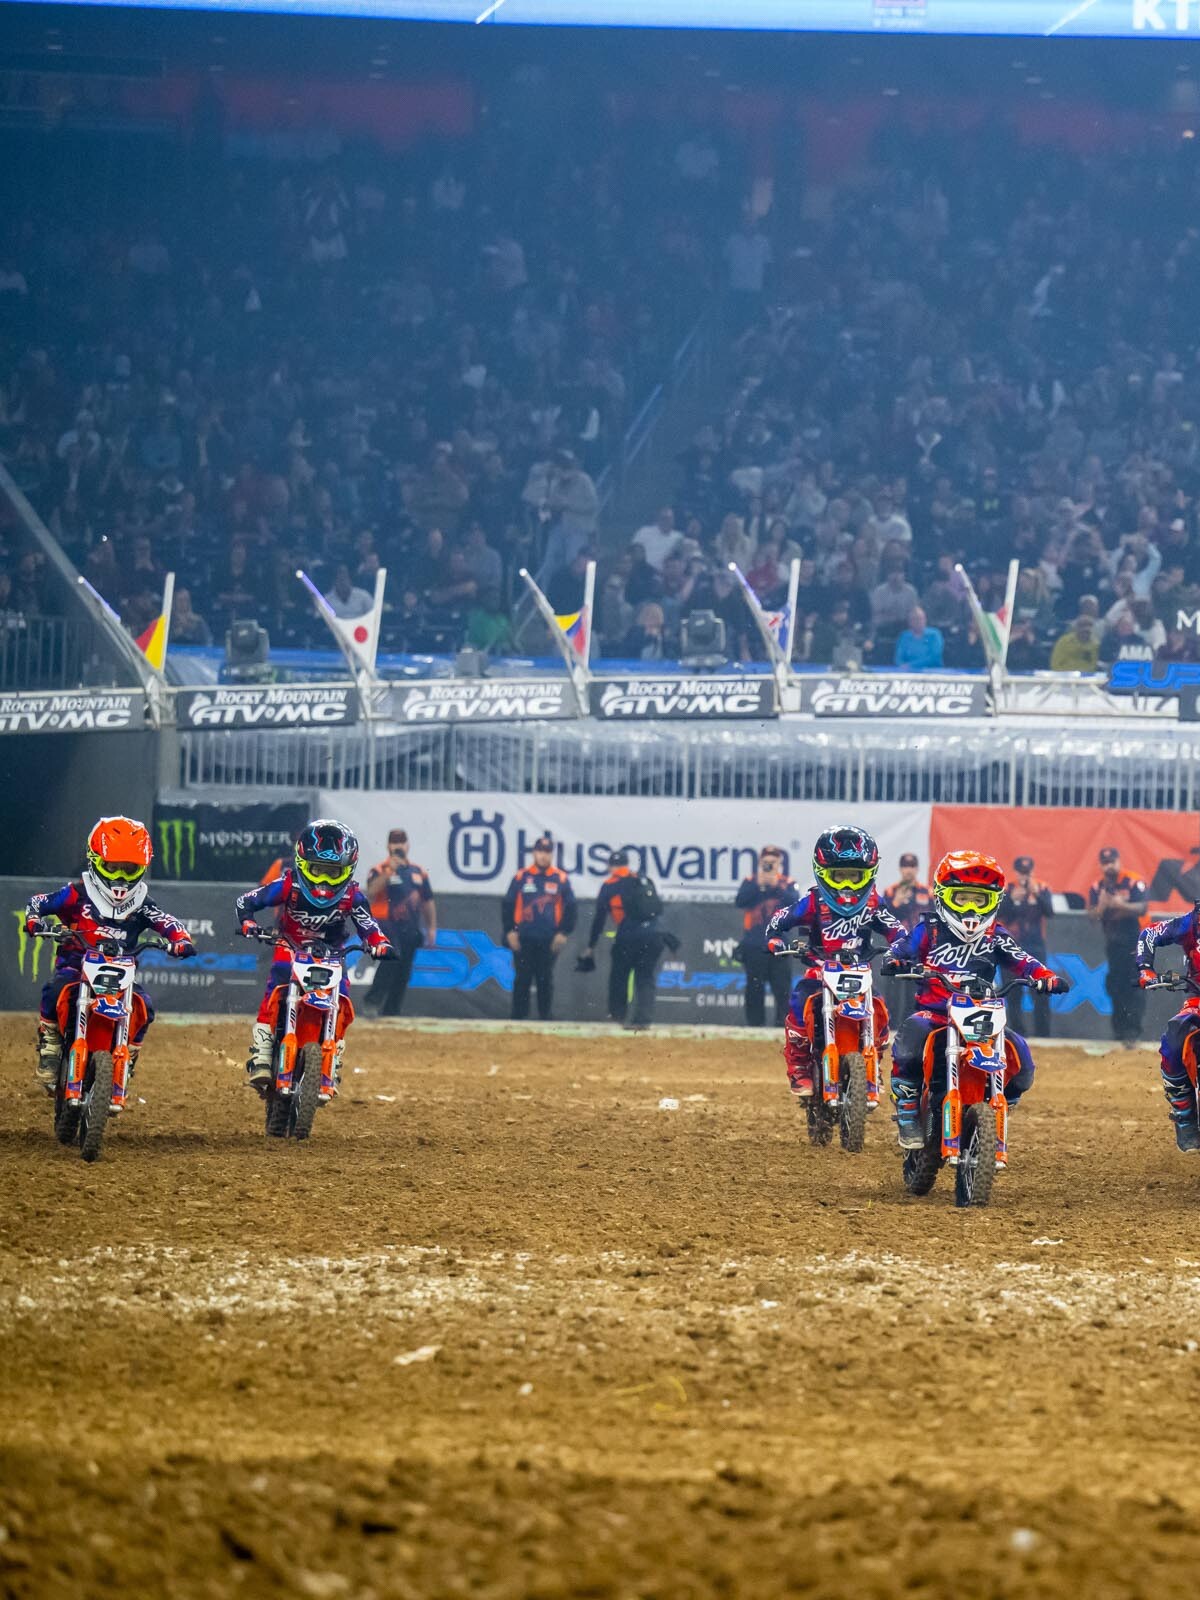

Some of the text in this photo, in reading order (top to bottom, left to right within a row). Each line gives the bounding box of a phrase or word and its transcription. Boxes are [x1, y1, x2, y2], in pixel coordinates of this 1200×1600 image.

[1119, 645, 1153, 661] AMA
[480, 684, 563, 698] MOUNTAIN
[677, 681, 762, 696] MOUNTAIN
[889, 680, 974, 695] MOUNTAIN
[51, 696, 131, 711] MOUNTAIN
[265, 689, 347, 704] MOUNTAIN
[836, 974, 863, 992] 5
[963, 1010, 993, 1033] 4
